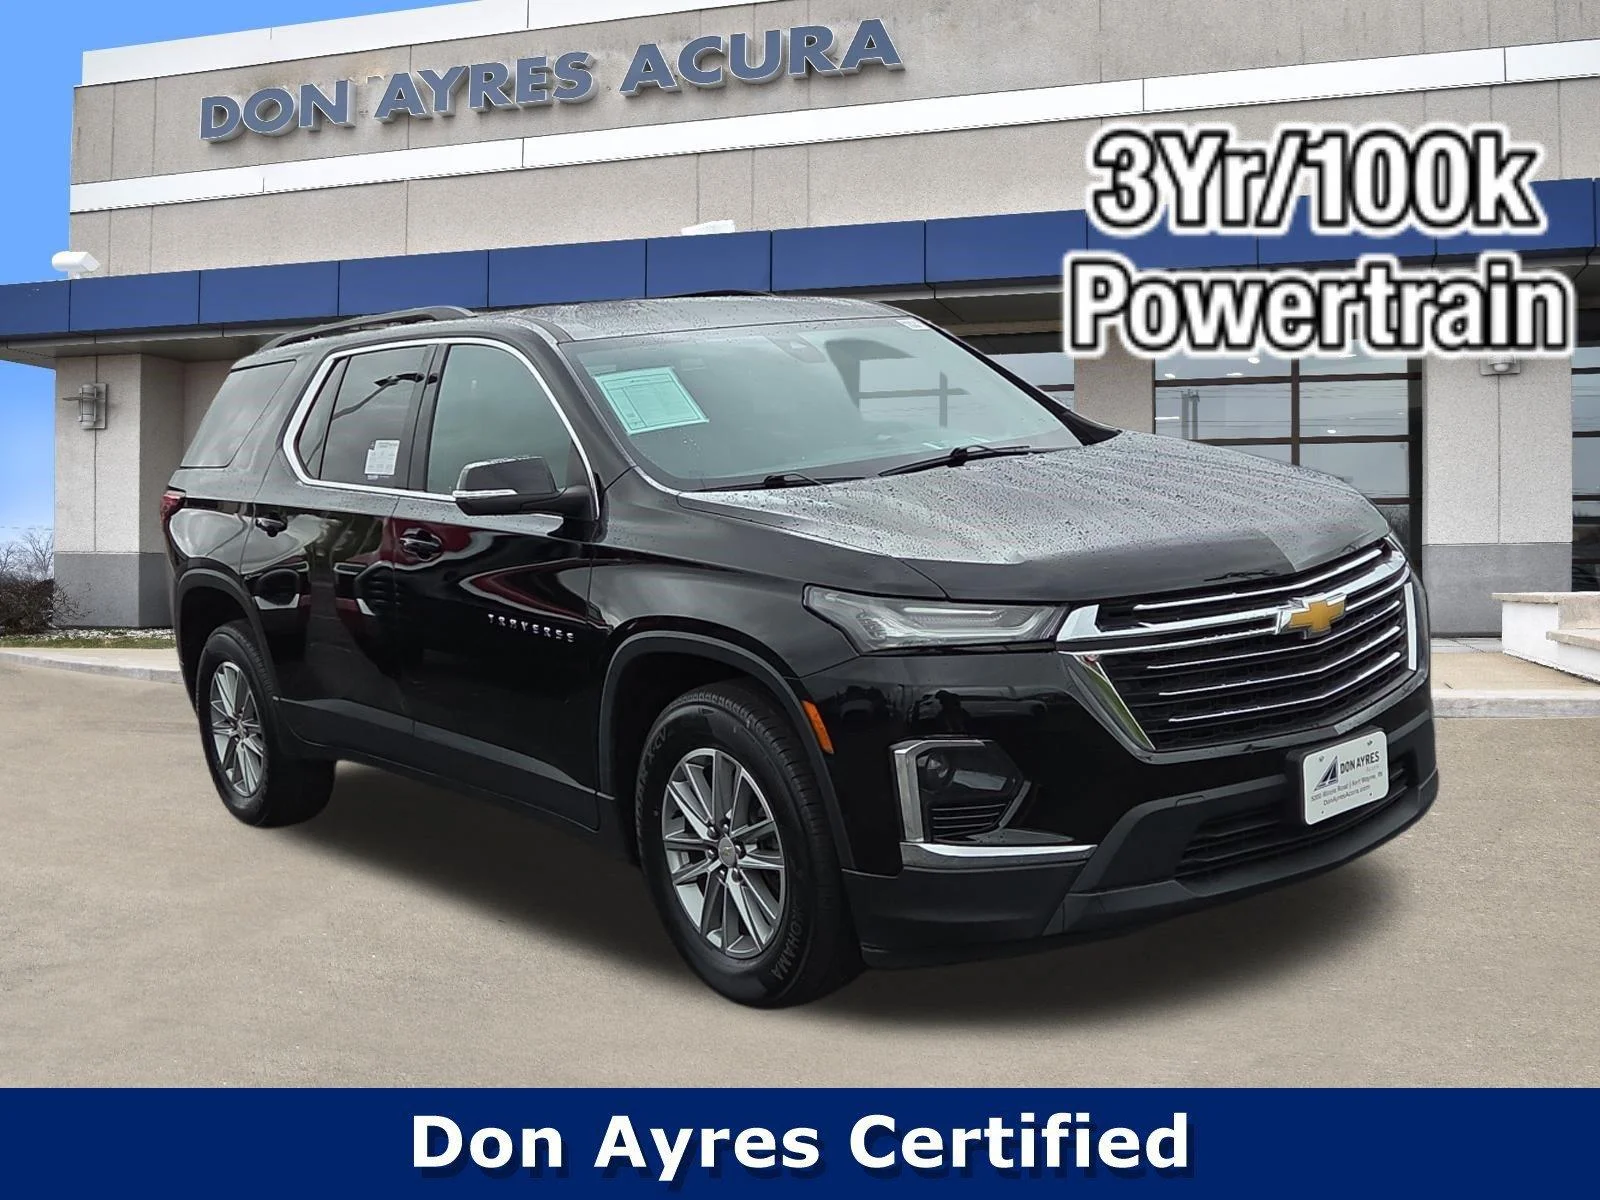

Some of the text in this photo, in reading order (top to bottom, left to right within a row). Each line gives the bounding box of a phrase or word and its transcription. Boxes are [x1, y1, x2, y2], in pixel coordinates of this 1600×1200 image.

[200, 18, 905, 142] DON AYRES ACURA
[487, 613, 575, 643] TRAVERSE
[1340, 759, 1356, 774] DON
[1356, 751, 1380, 768] AYRES
